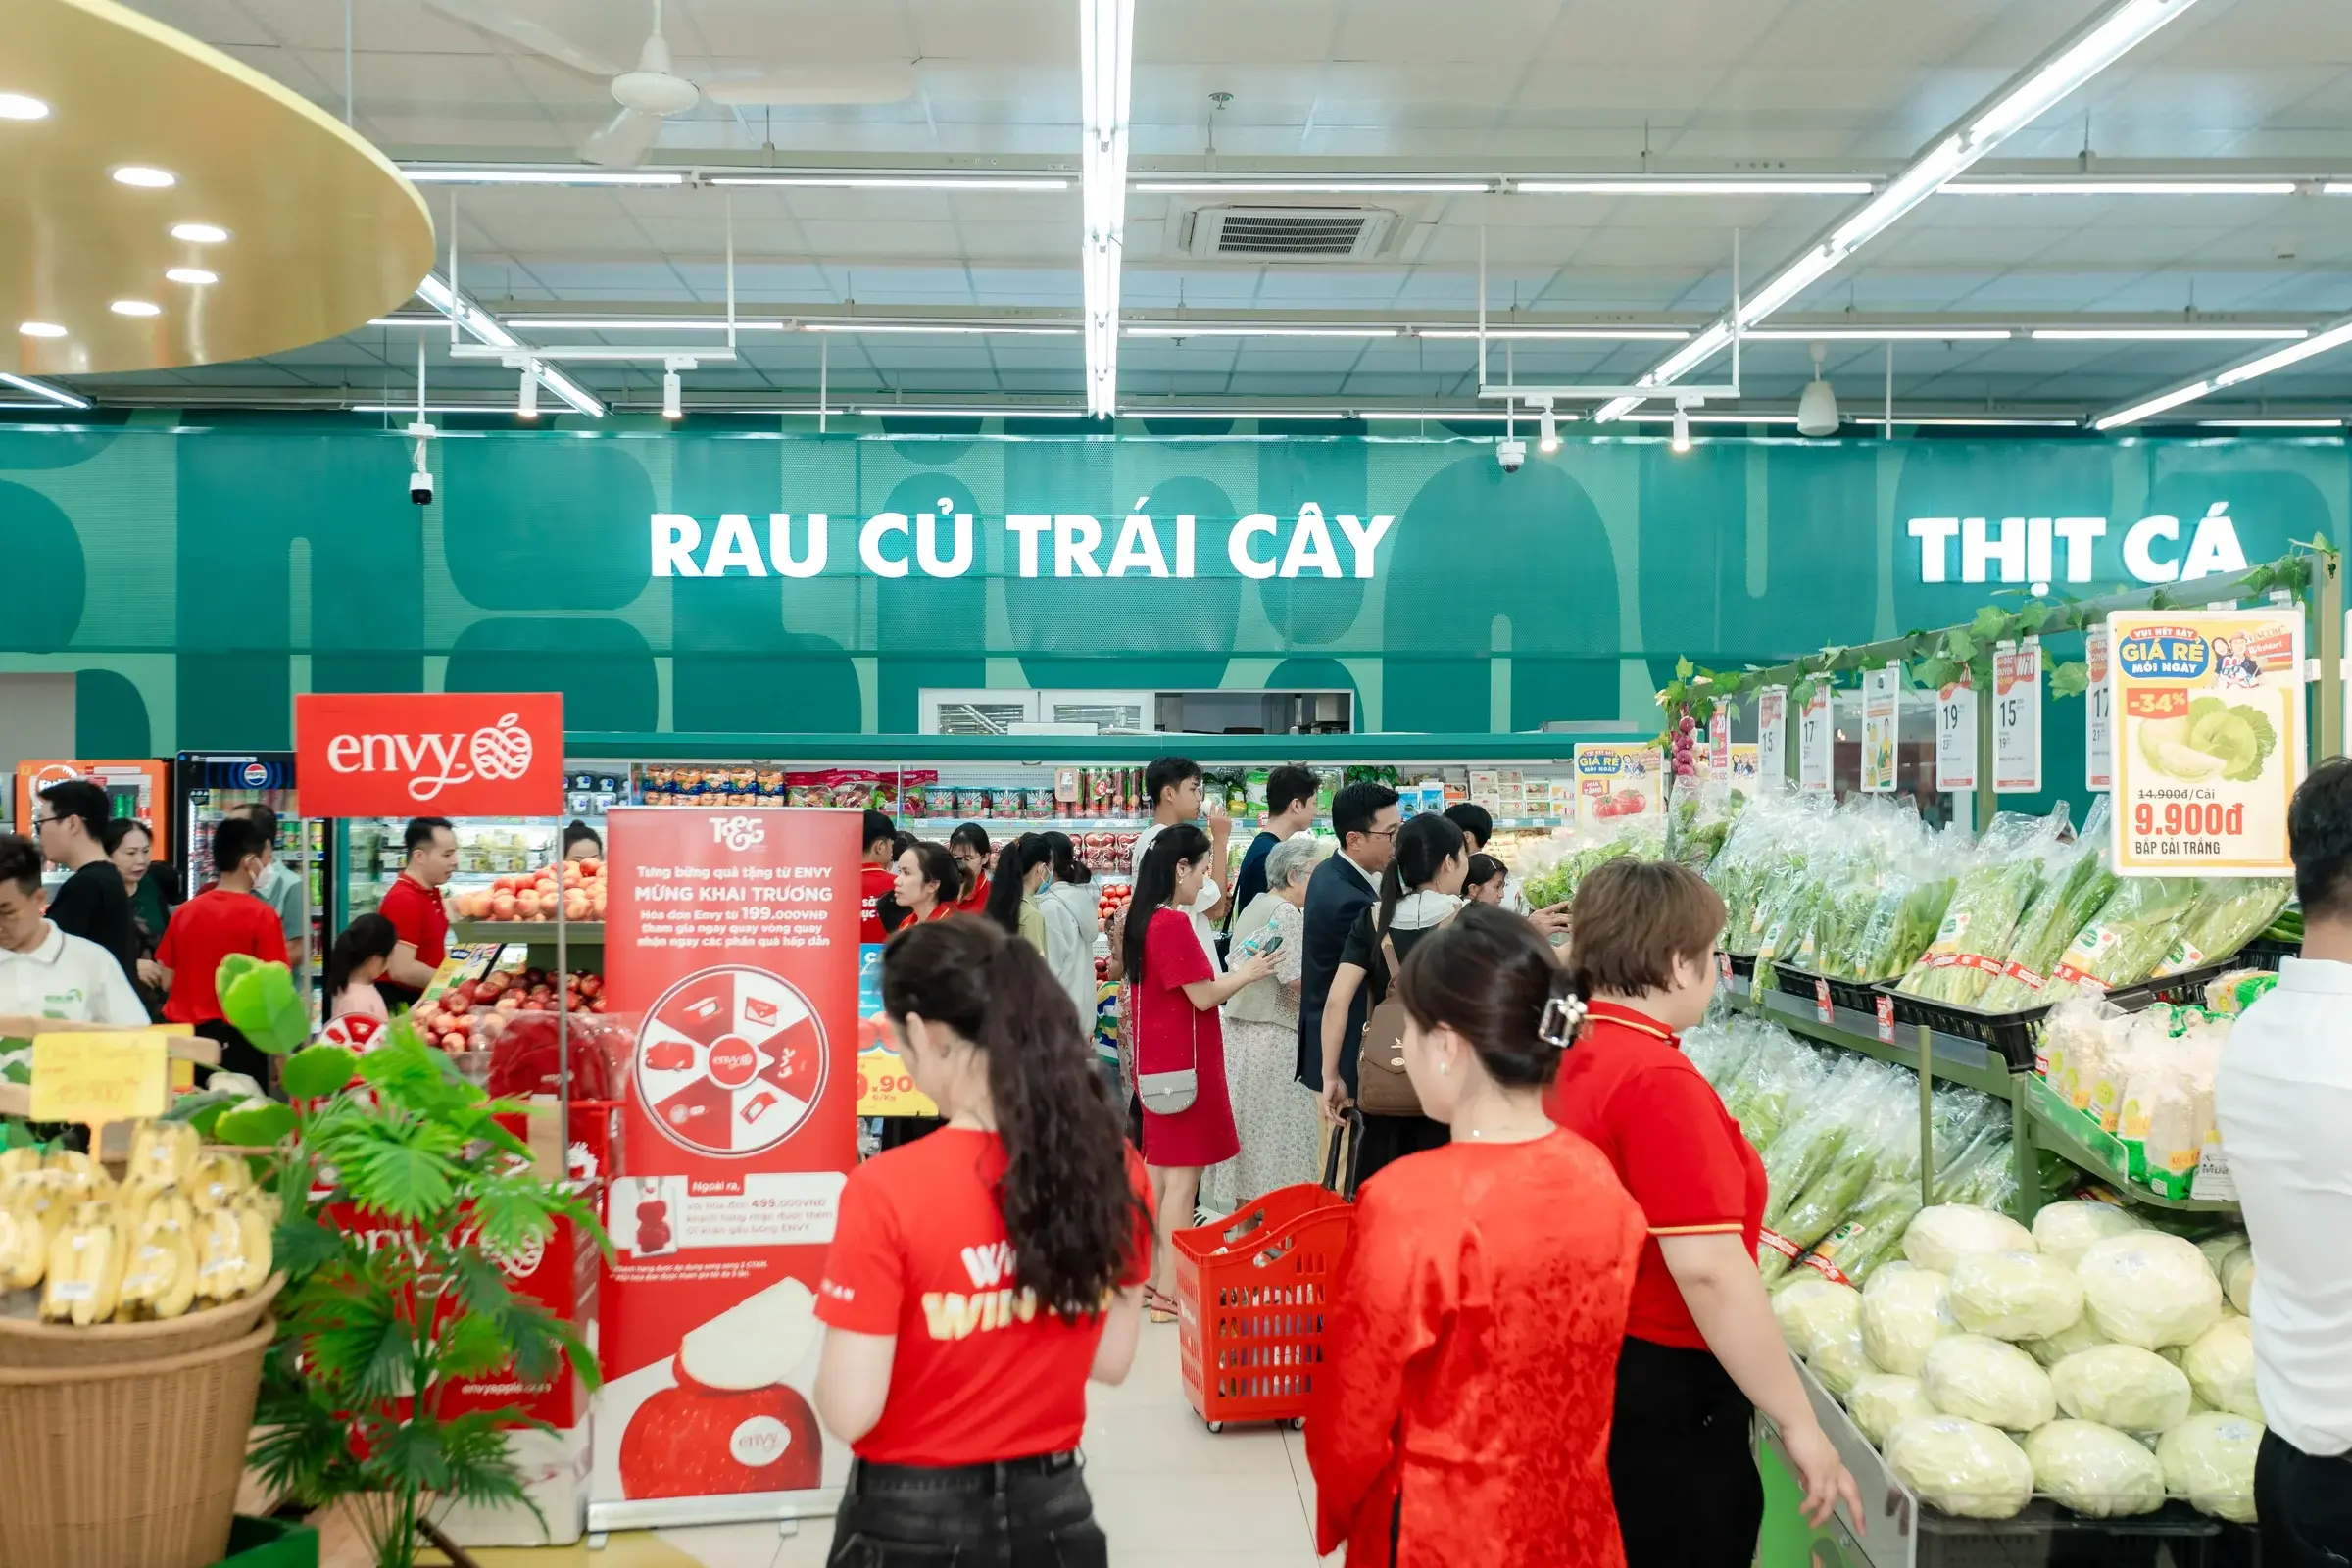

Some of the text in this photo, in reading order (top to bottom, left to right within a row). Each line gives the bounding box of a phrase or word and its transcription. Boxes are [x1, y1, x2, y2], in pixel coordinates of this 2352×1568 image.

[651, 497, 1394, 579] RAU CỦ TRÁI CÂY
[1908, 502, 2247, 596] THỊT CÁ
[2134, 629, 2151, 638] VUI
[2122, 637, 2166, 662] GIÁ
[2172, 636, 2204, 662] RẺ
[1999, 699, 2017, 727] 15
[2130, 693, 2186, 713] -34%
[1942, 704, 1958, 730] 19
[327, 734, 474, 801] envy
[1579, 755, 1600, 766] GIÁ
[2135, 803, 2244, 835] 9.900đ
[2135, 837, 2157, 855] BẮP
[2183, 837, 2221, 855] TRẮNG
[794, 866, 833, 878] ENVY
[634, 883, 833, 902] MỪNG KHAI TRƯƠNG
